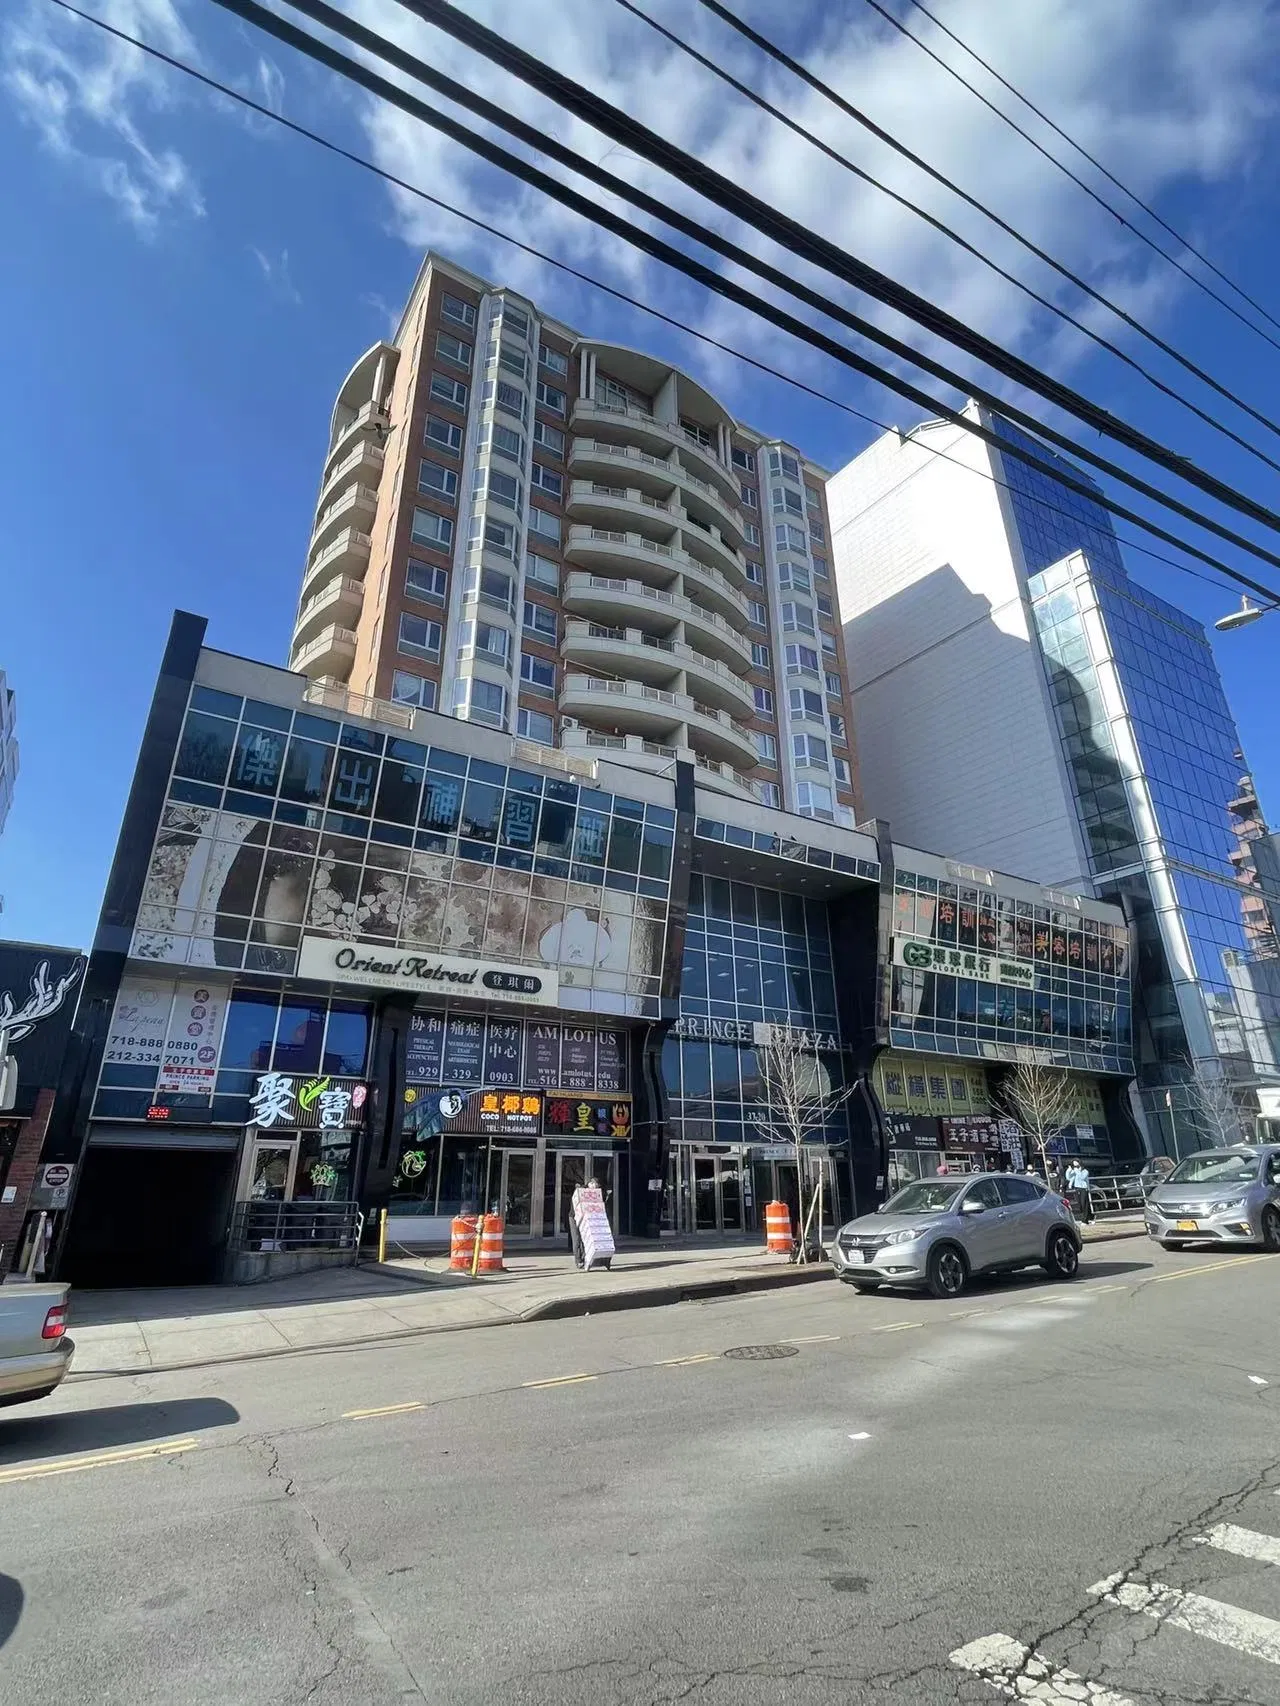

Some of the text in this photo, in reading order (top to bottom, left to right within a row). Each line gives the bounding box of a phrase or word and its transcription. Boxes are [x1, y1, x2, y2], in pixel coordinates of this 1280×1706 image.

[335, 947, 479, 985] Orient Retreat
[932, 964, 965, 976] GLOBAL
[674, 1017, 748, 1041] PRINCE
[489, 1042, 517, 1059] 中心
[418, 1066, 438, 1077] 929
[452, 1068, 471, 1079] 329
[489, 1071, 514, 1083] 0903
[540, 1075, 557, 1085] 516
[569, 1077, 586, 1087] 888
[598, 1080, 619, 1089] 8338
